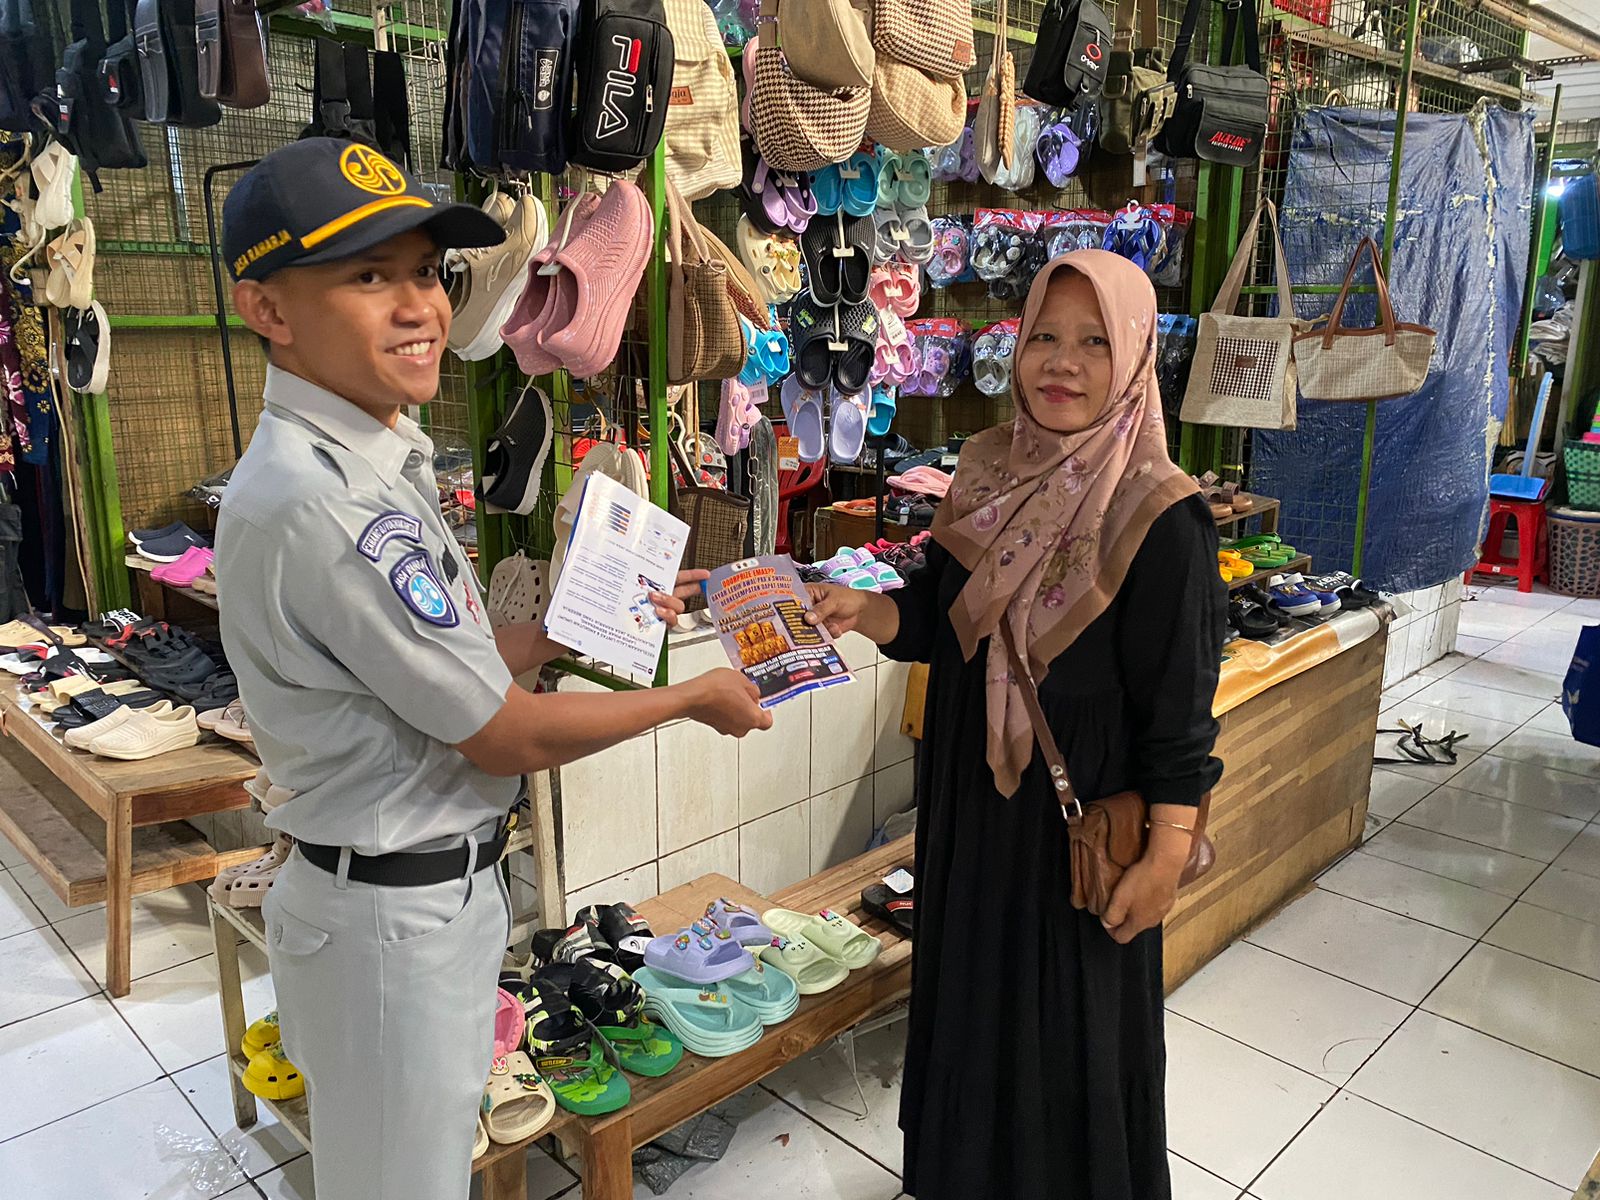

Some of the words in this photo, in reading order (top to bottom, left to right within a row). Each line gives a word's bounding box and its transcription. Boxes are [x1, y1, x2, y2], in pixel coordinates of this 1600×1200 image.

[596, 34, 642, 139] FILA
[233, 254, 249, 277] JASA
[248, 229, 293, 262] RAHARJA
[722, 570, 752, 587] DOORPRIZE
[712, 589, 727, 602] BAYAR
[728, 584, 741, 594] LEBIH
[742, 579, 755, 587] AWAL
[721, 585, 760, 606] BERKESEMPATAN
[563, 606, 582, 616] BEKERJA
[573, 621, 596, 633] ANGKUTAN
[594, 620, 614, 631] RAHARJA
[600, 633, 615, 642] LINTAS
[622, 636, 636, 644] LAPOR
[627, 633, 655, 648] SELANJUTNYA
[628, 644, 654, 657] KECELAKAAN
